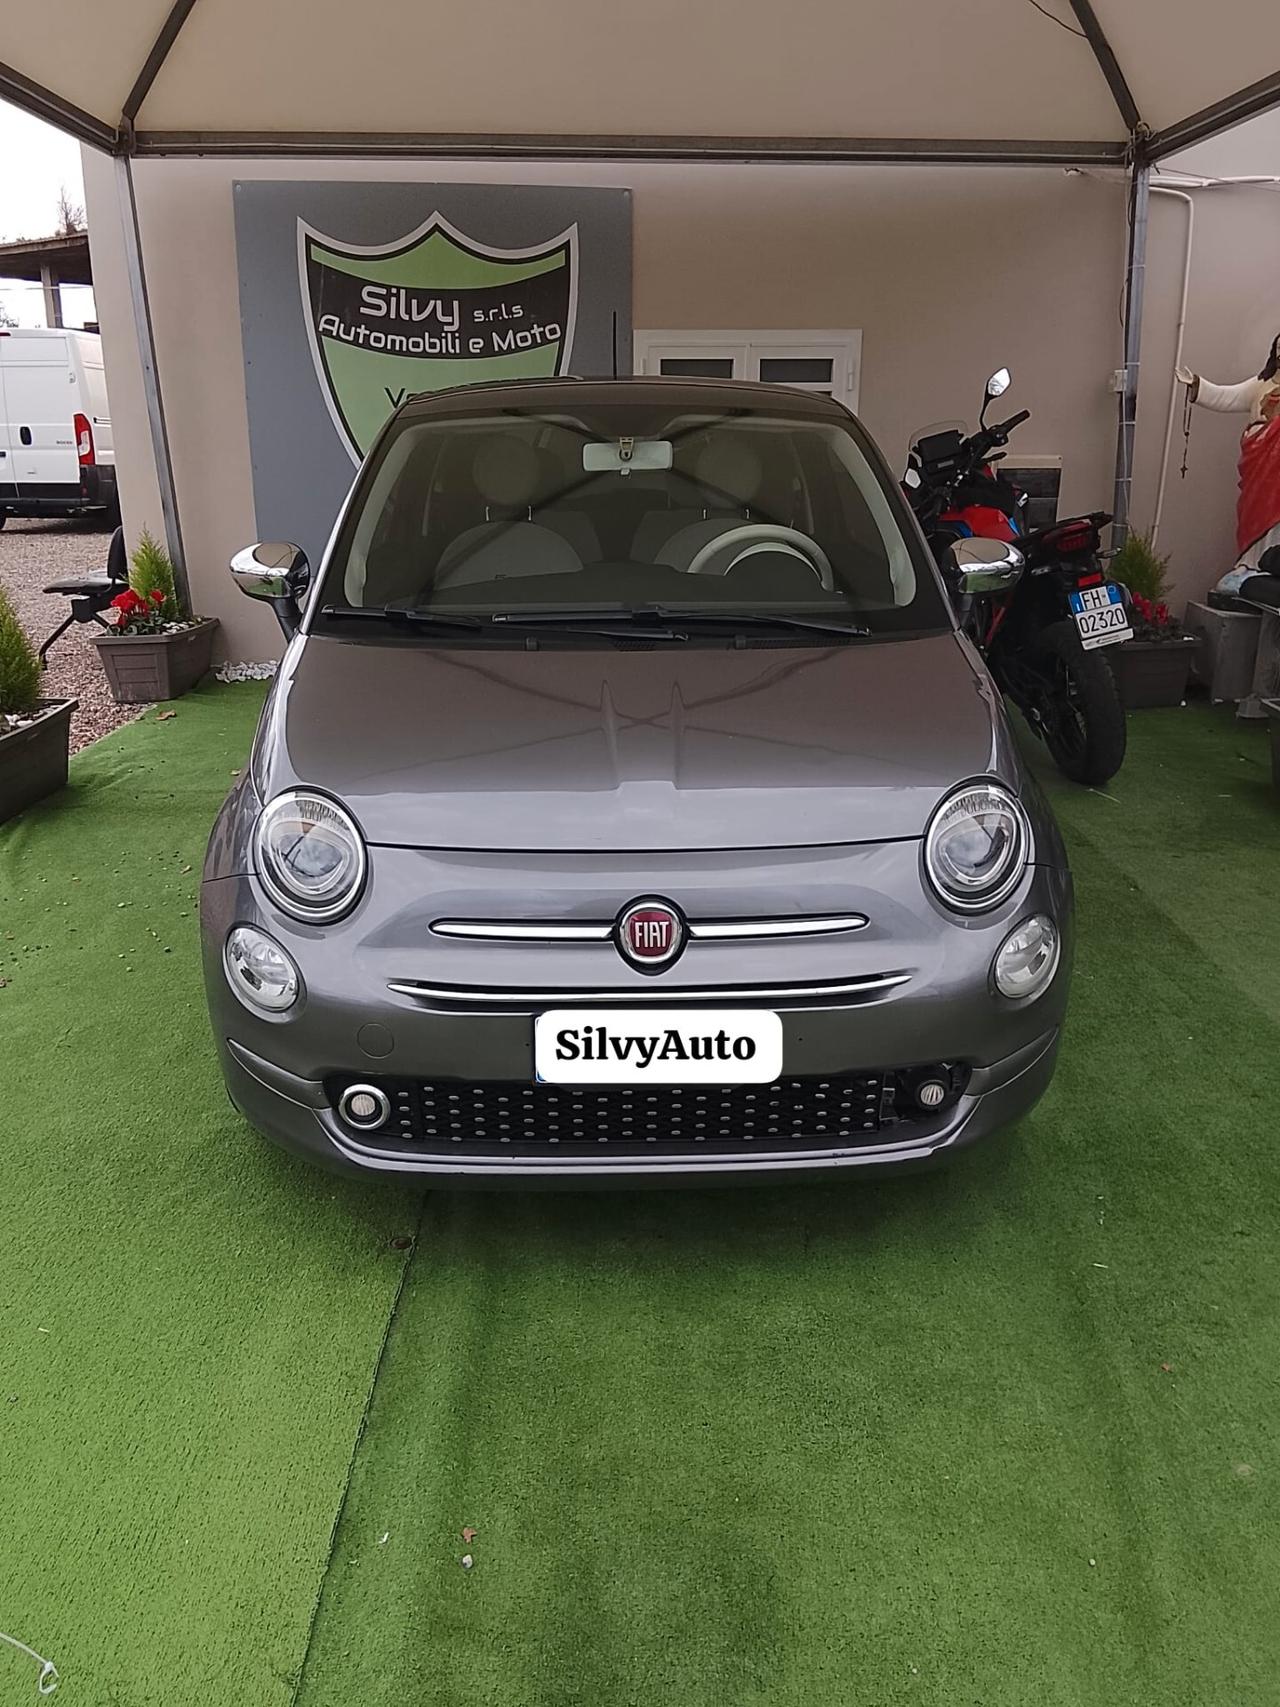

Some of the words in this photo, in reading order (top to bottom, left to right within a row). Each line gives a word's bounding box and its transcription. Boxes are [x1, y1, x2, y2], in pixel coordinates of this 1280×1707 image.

[359, 285, 460, 332] Silvy
[473, 303, 524, 323] s.r.l.s
[318, 313, 461, 354] Automobili
[469, 339, 484, 354] e
[492, 321, 561, 353] Moto
[1081, 590, 1102, 610] FH
[1079, 608, 1125, 633] 02320
[634, 921, 669, 948] FIAT
